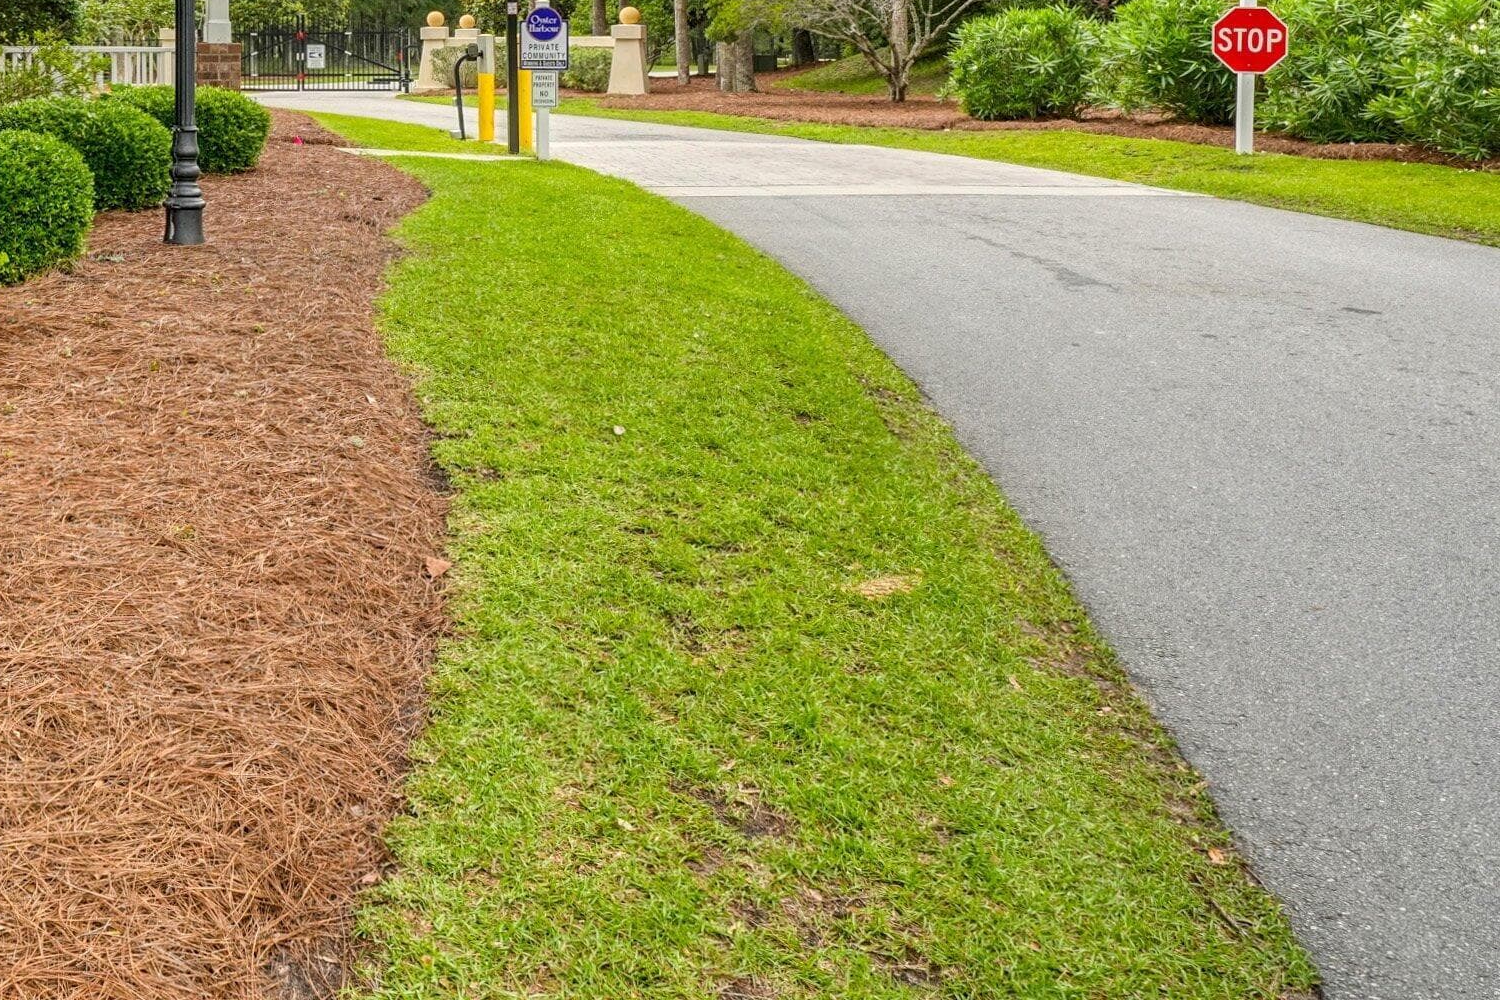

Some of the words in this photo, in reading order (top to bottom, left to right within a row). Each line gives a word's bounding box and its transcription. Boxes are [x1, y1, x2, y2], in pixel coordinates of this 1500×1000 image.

[530, 15, 557, 26] Oyster
[529, 24, 559, 32] Harbour
[1217, 27, 1283, 53] STOP
